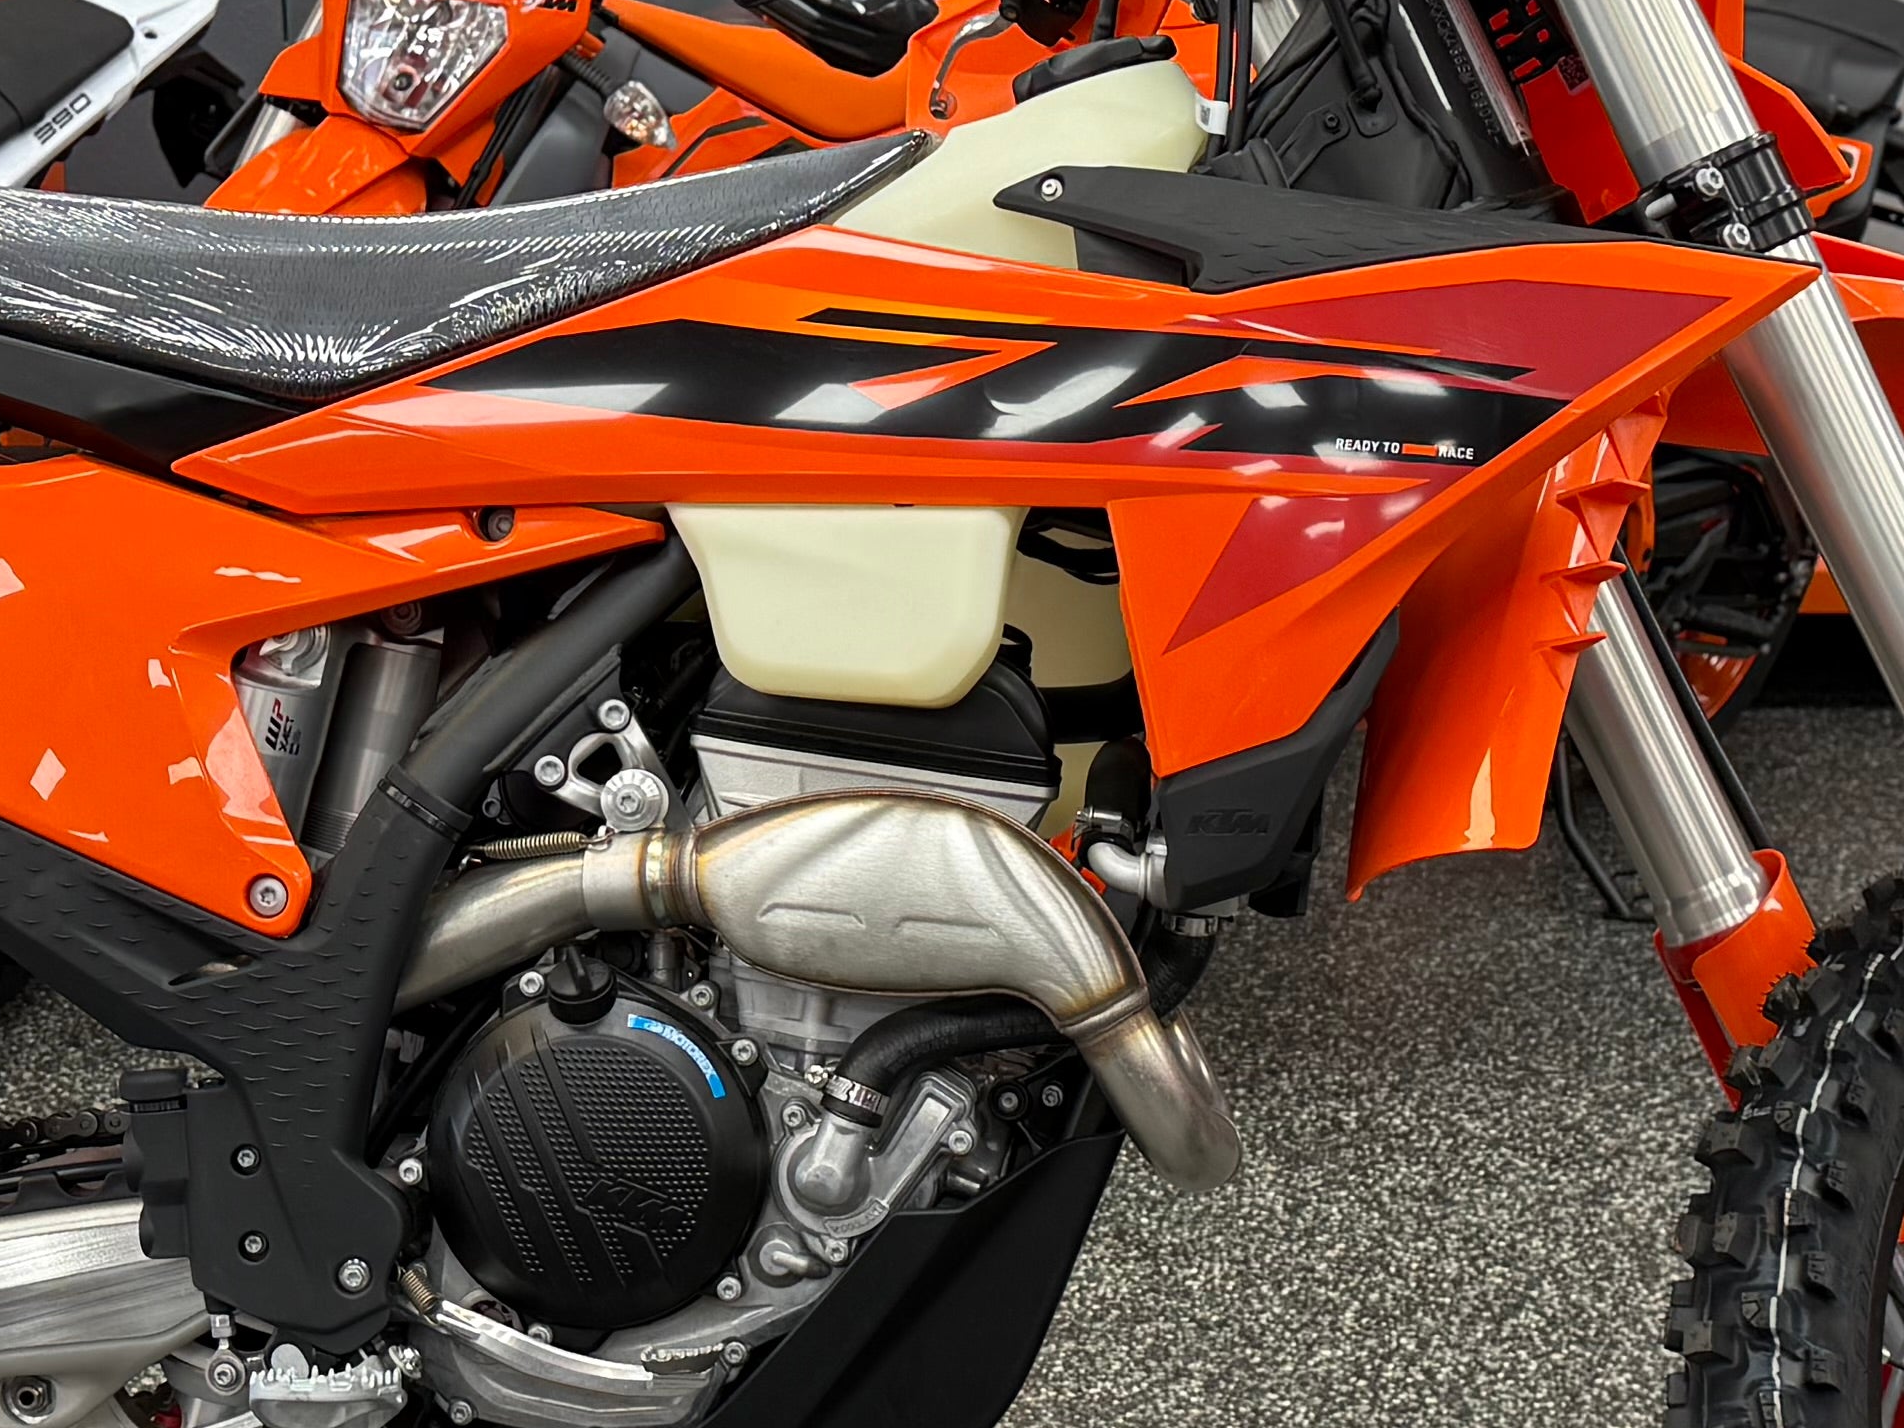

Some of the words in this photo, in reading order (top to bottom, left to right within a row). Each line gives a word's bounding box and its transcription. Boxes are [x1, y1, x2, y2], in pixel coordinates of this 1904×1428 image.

[33, 94, 92, 145] 390
[1335, 437, 1380, 452] READY
[1383, 441, 1401, 454] TO
[1438, 445, 1474, 460] RACE
[1186, 808, 1272, 836] KTM
